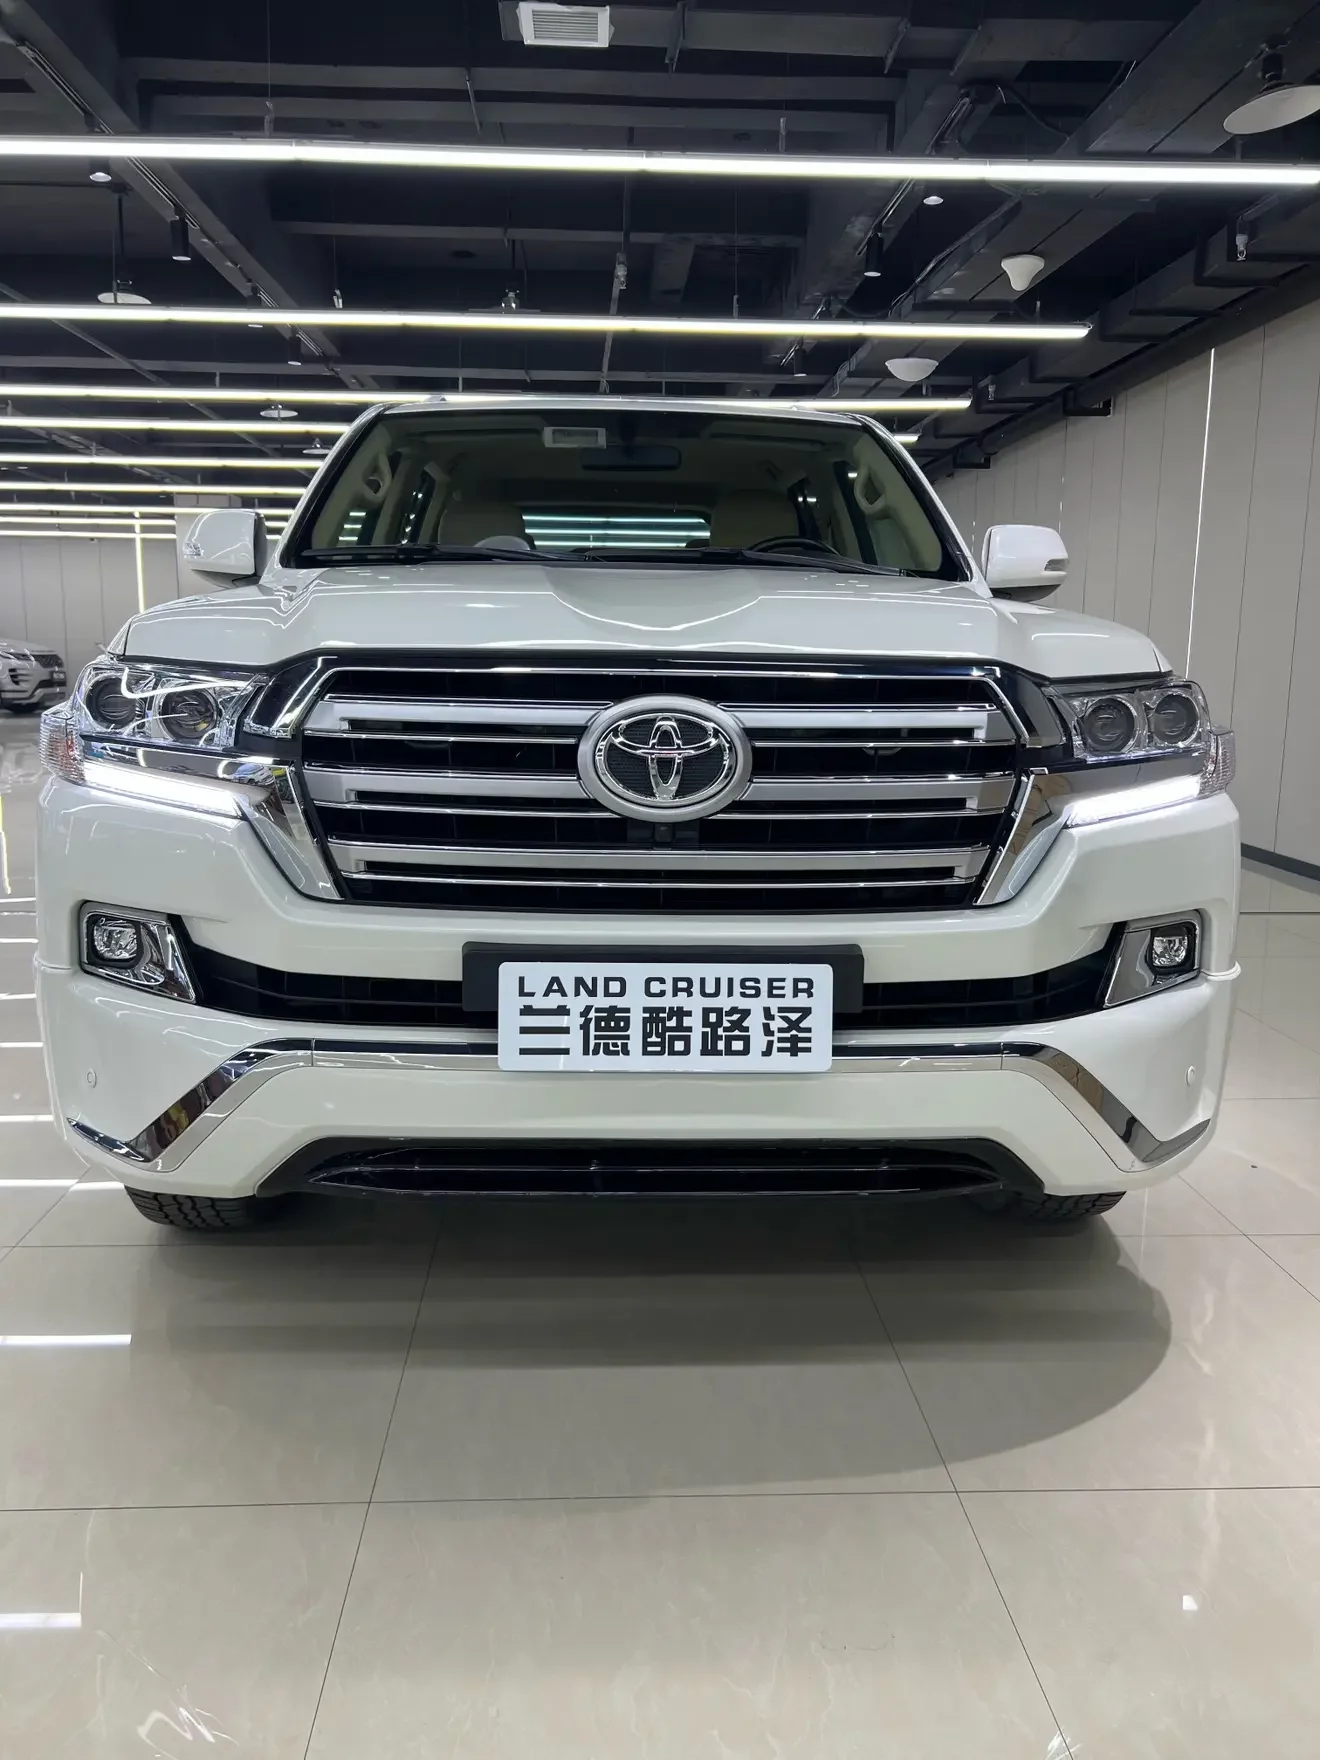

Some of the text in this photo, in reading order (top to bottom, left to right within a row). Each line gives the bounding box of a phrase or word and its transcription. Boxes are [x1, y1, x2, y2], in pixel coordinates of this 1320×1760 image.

[518, 976, 814, 998] LAND CRUISER
[518, 1004, 813, 1057] 兰德酷路泽
